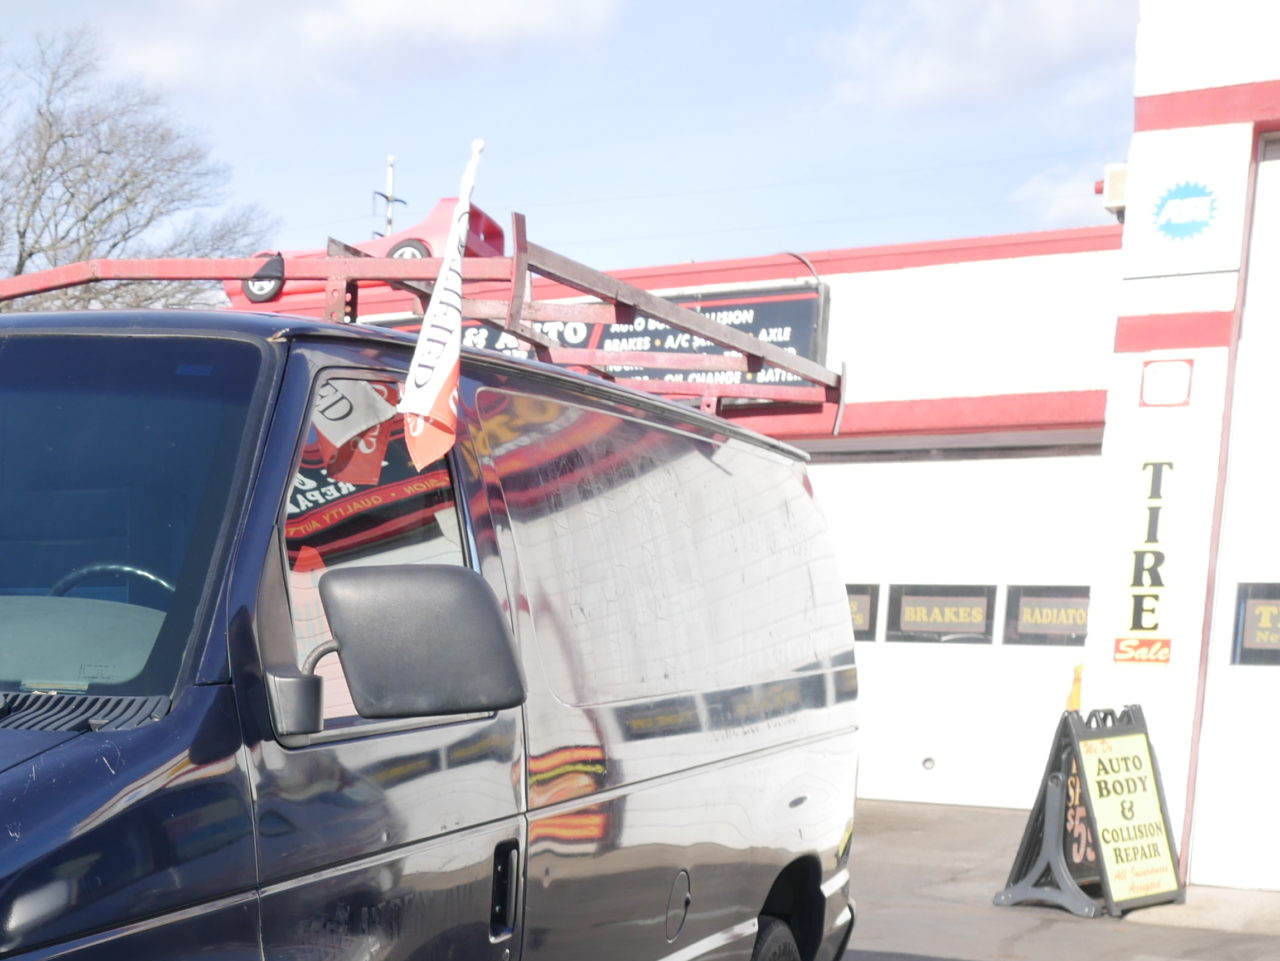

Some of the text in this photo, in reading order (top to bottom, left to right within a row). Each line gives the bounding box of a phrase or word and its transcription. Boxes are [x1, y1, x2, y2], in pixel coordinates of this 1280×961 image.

[495, 321, 587, 349] ATO
[610, 317, 645, 333] AUO
[758, 327, 792, 342] AXLE
[604, 336, 650, 351] BRAKES
[665, 333, 691, 348] A/C
[687, 371, 741, 384] CHANGE
[1129, 461, 1174, 631] TIRE
[904, 606, 984, 624] BRAKES
[1115, 639, 1170, 660] Sale
[1096, 754, 1143, 776] AUTO
[1096, 776, 1148, 798] BODY
[1120, 800, 1135, 820] &
[1101, 821, 1163, 844] COLLISION
[1113, 843, 1161, 865] REPAIR
